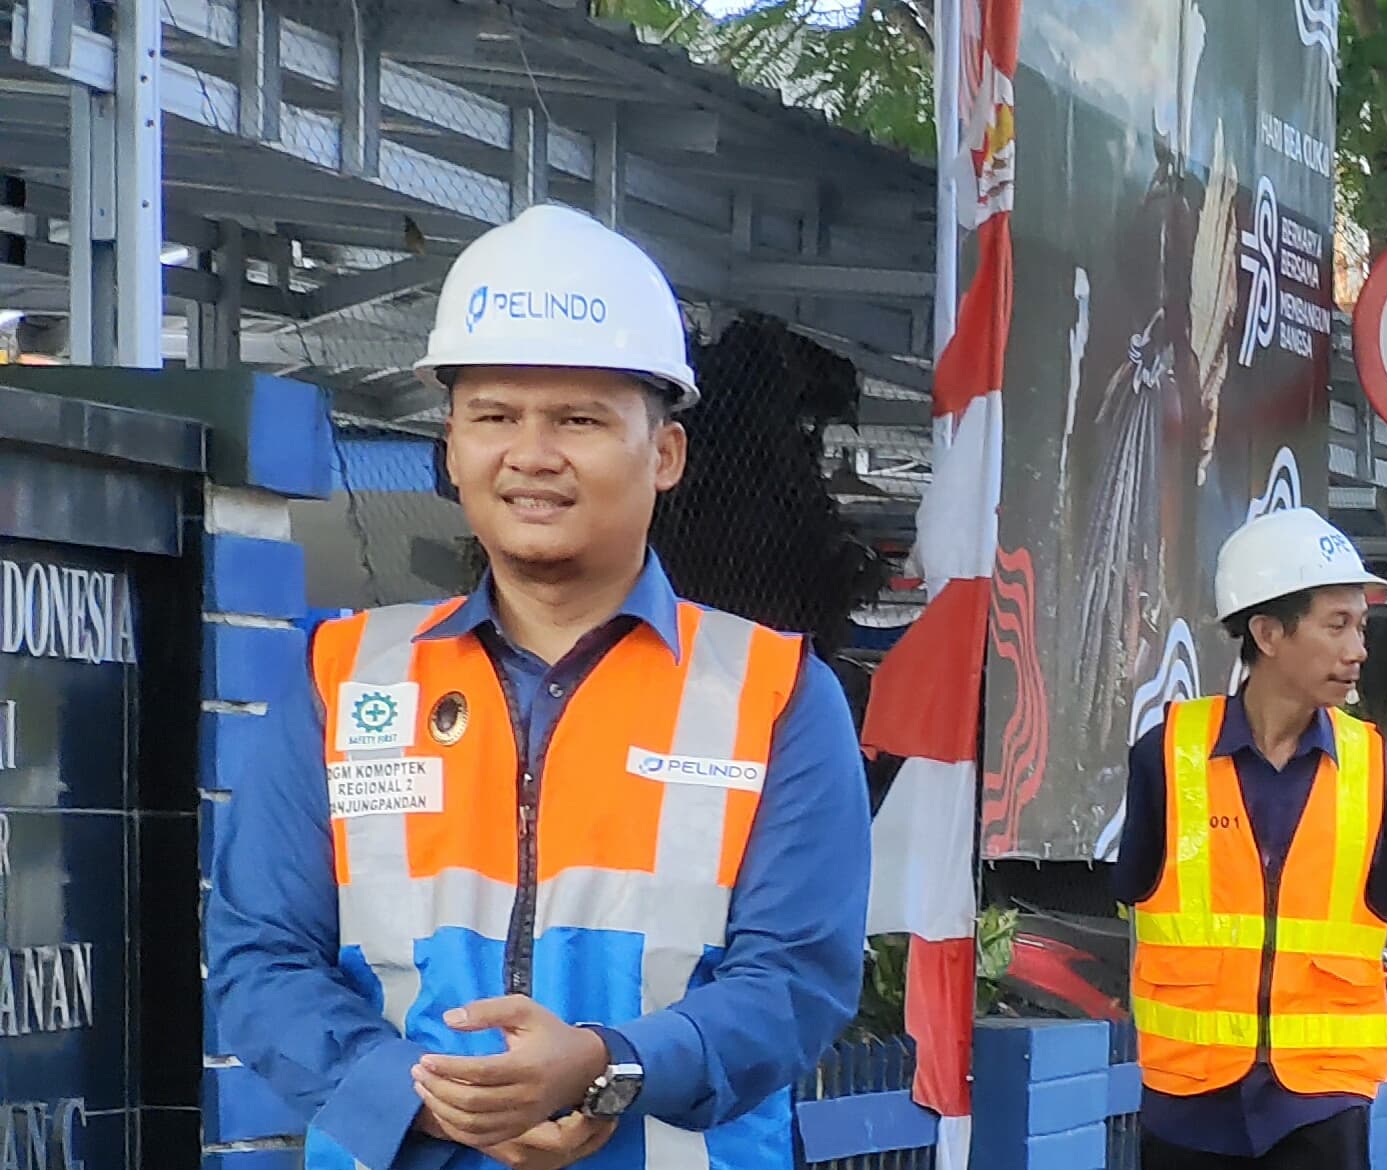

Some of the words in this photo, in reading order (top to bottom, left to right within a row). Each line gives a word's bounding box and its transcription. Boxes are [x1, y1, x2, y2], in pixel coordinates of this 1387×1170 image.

[1283, 122, 1303, 163] BEA
[493, 291, 607, 323] PELINDO
[0, 559, 137, 665] DONESIA
[355, 761, 427, 779] KOMOPTEK
[668, 759, 758, 780] PELINDO
[338, 781, 402, 796] REGIONAL
[405, 778, 413, 791] 2
[330, 796, 427, 816] ANJUNGPANDAN
[1209, 815, 1240, 829] 001
